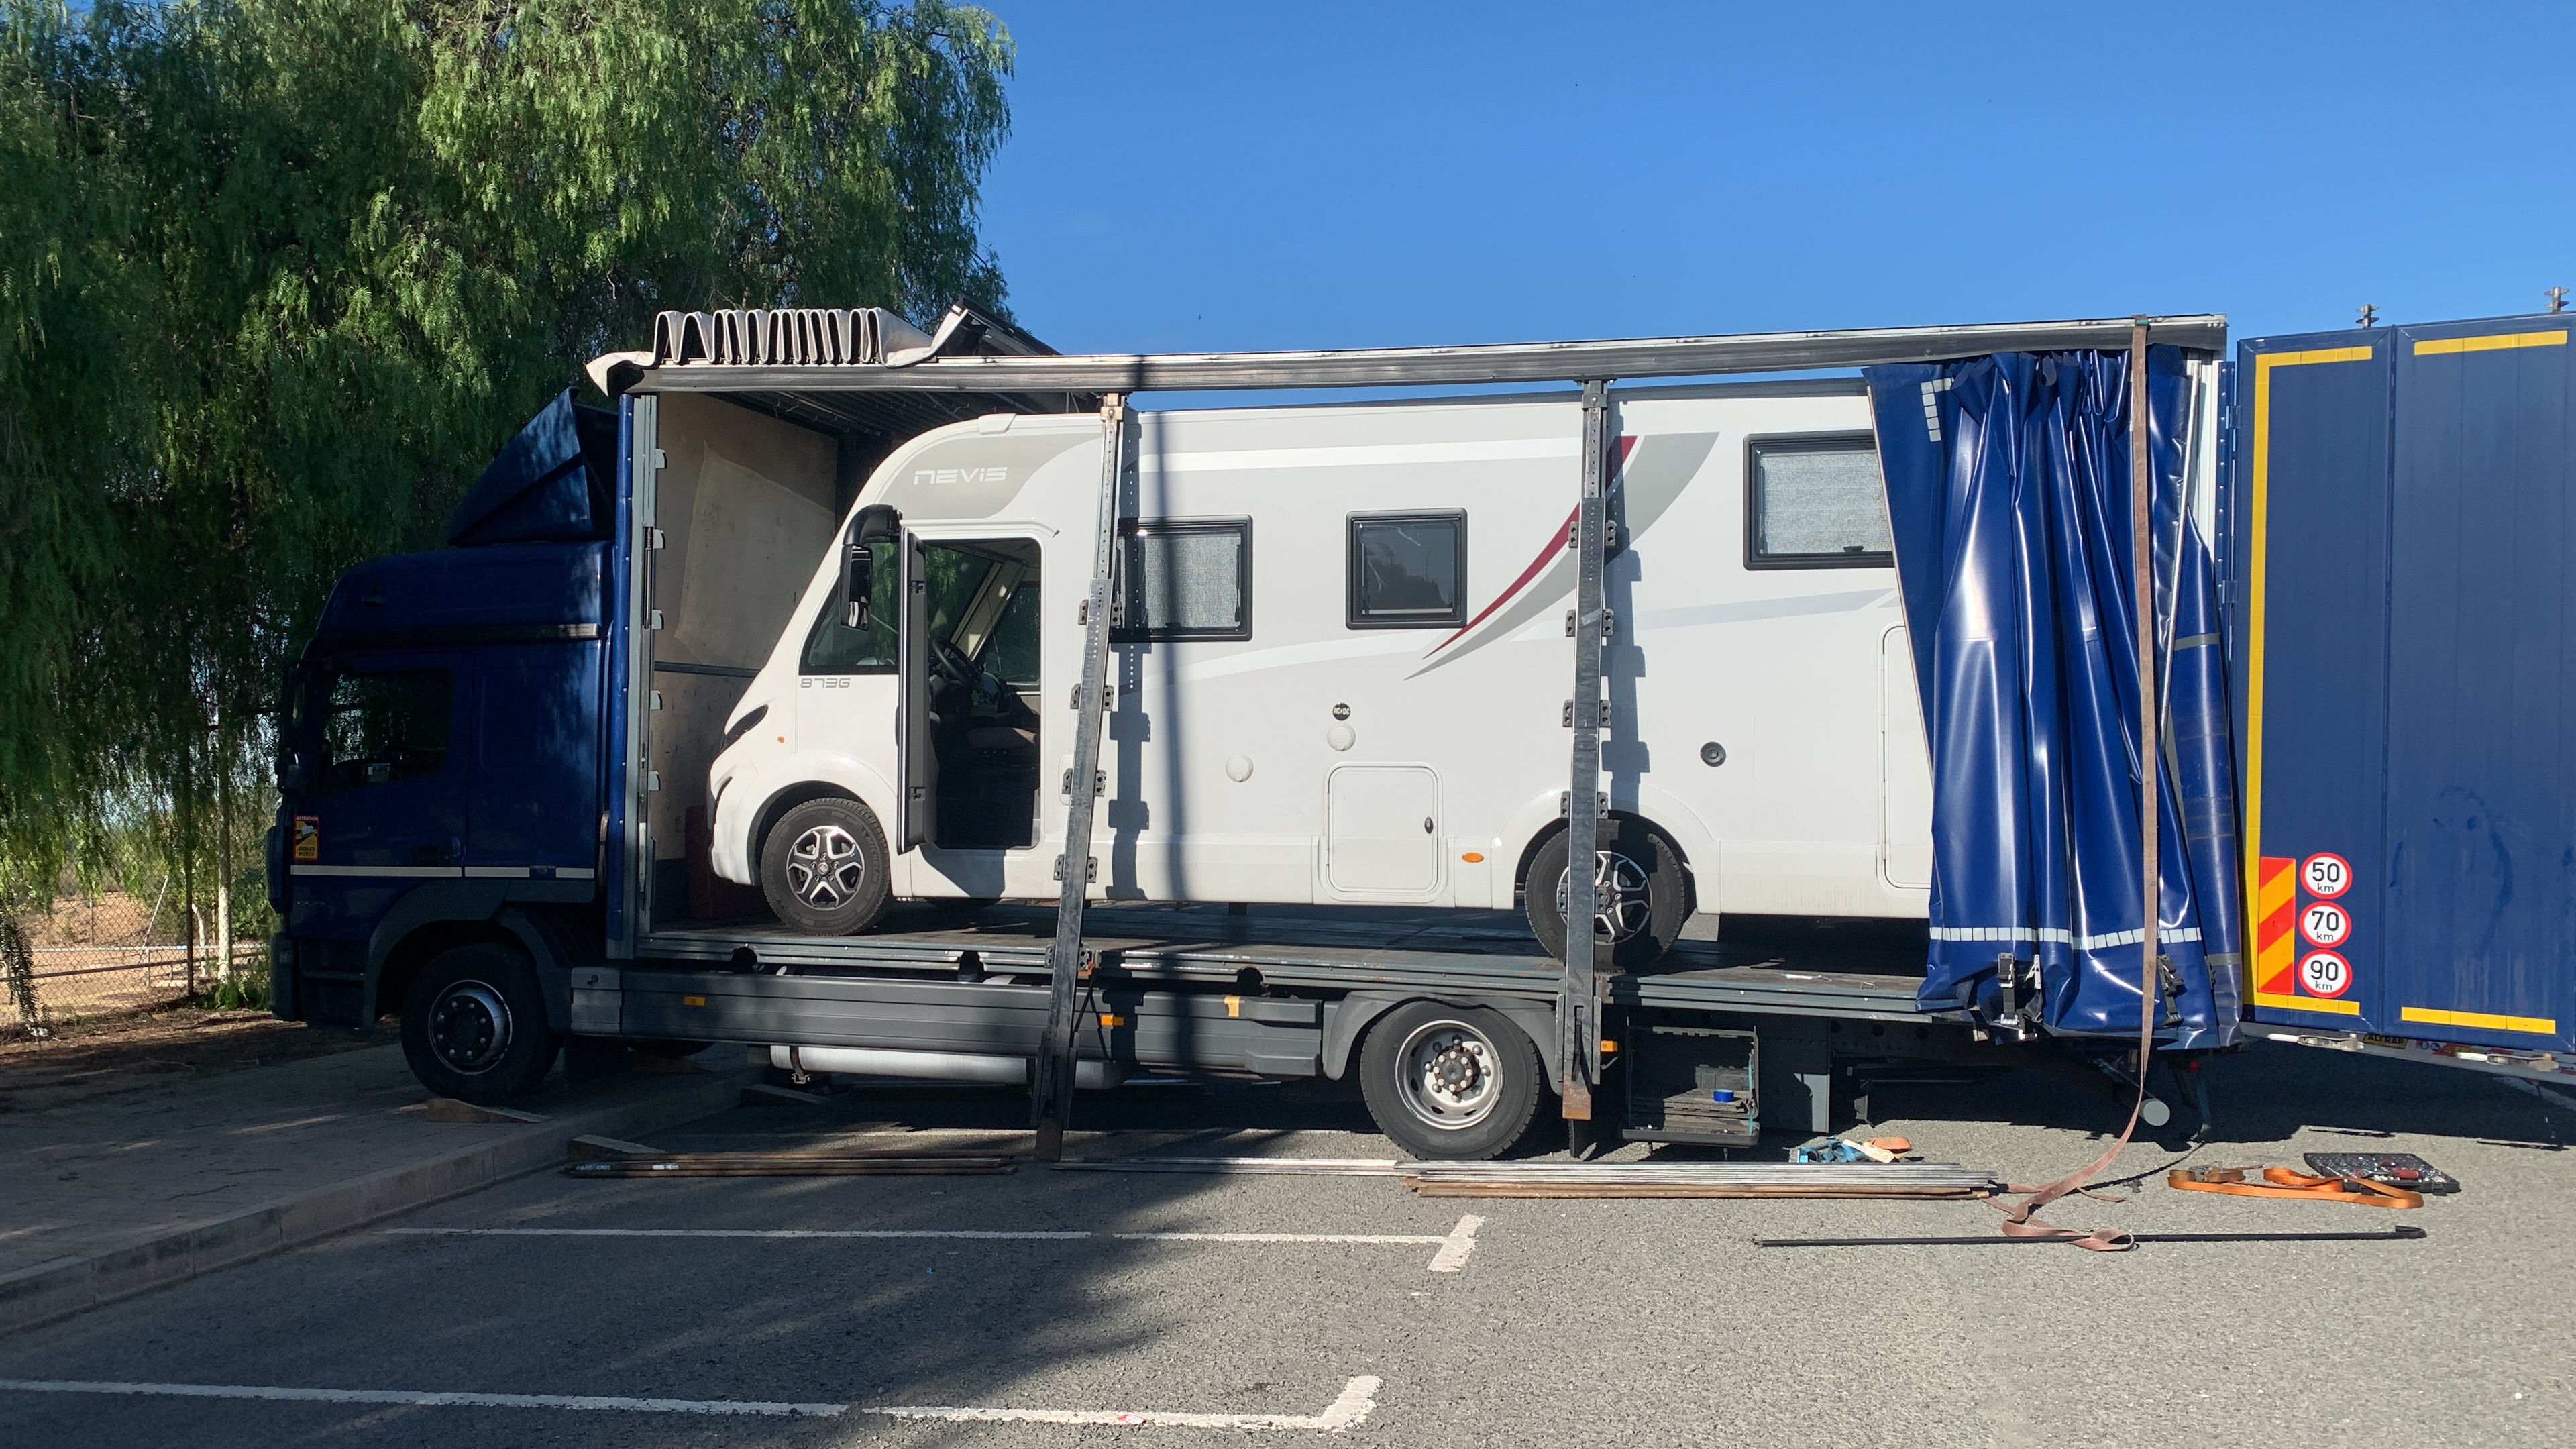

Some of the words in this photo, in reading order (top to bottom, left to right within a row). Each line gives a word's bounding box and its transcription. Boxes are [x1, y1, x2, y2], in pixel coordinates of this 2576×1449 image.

[800, 677, 851, 688] 873G
[1333, 706, 1350, 716] AC/DC
[2312, 861, 2341, 883] 50
[2317, 883, 2335, 893] km
[2311, 910, 2340, 932] 70
[2316, 932, 2334, 941] km
[2310, 959, 2339, 981] 90
[2314, 980, 2333, 991] km
